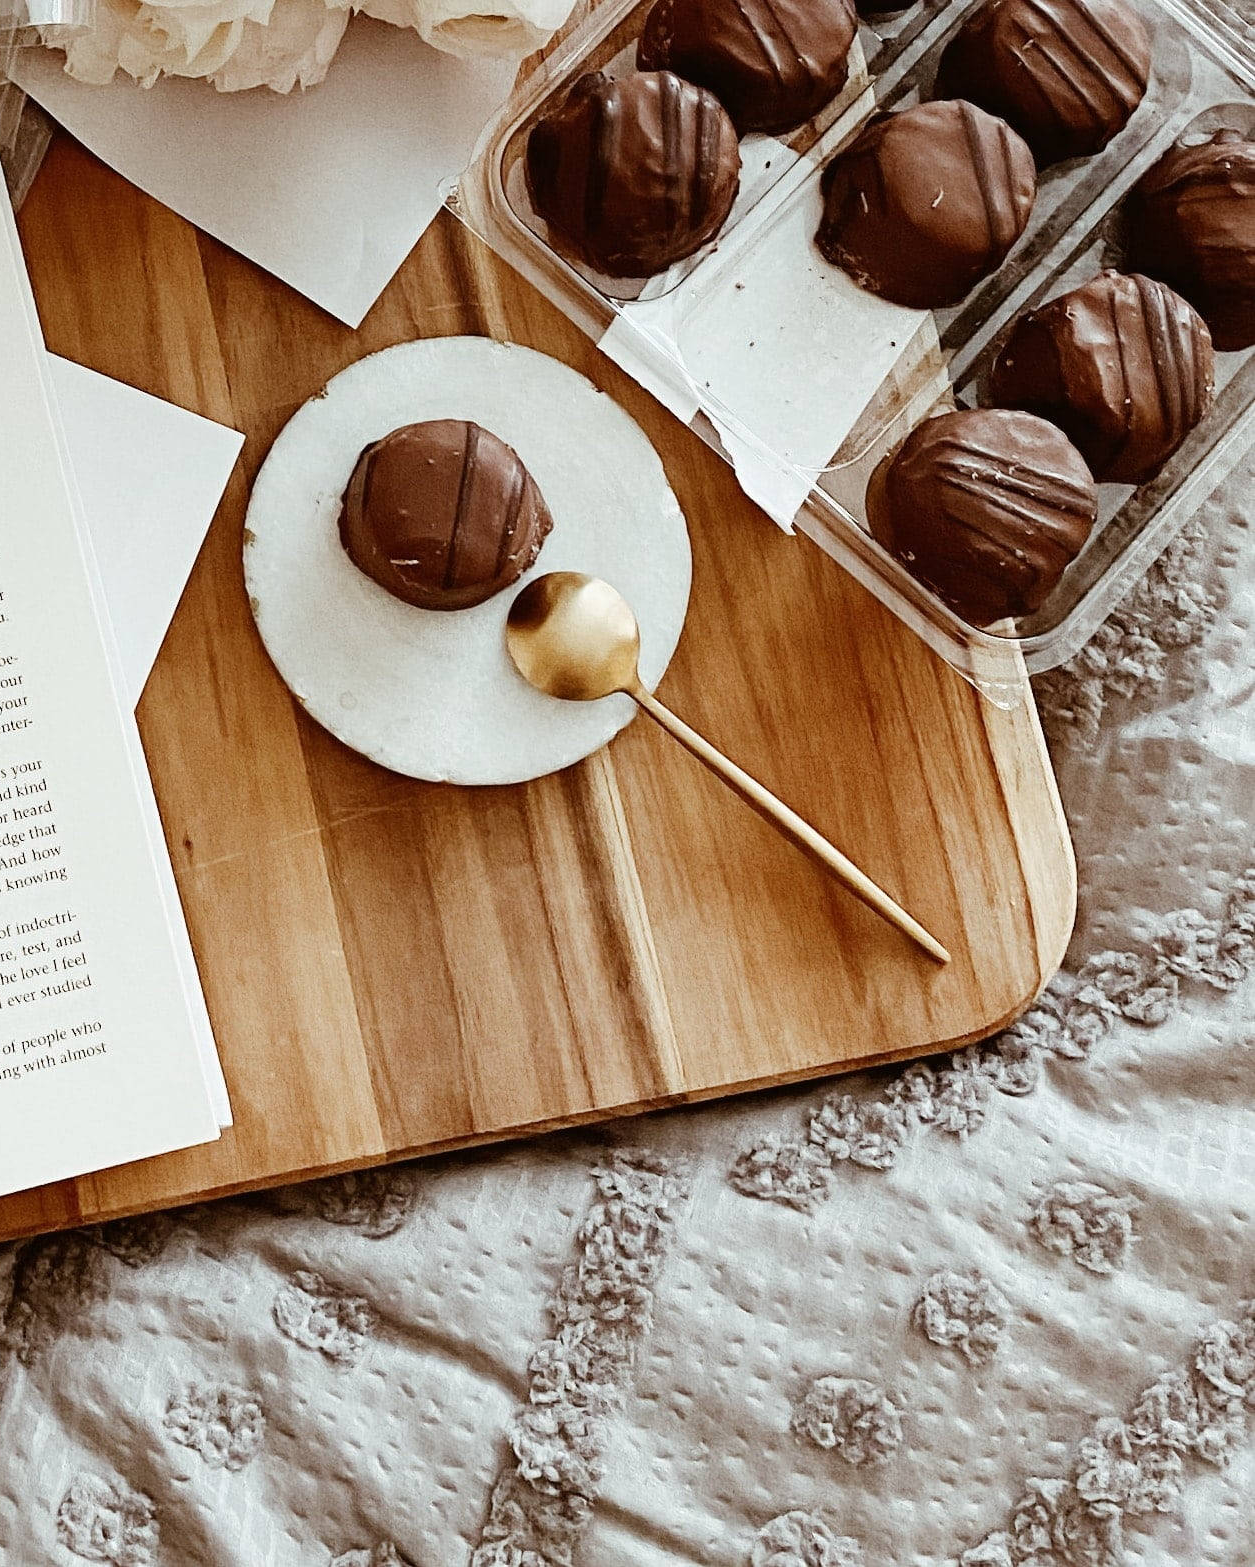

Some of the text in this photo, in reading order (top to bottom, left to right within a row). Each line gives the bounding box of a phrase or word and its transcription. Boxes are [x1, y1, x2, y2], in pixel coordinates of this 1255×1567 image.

[14, 777, 48, 798] kind
[12, 799, 53, 822] heard
[4, 867, 69, 892] knowing
[55, 929, 82, 949] and
[2, 1039, 17, 1056] of
[21, 1028, 68, 1055] people
[70, 1019, 103, 1038] who
